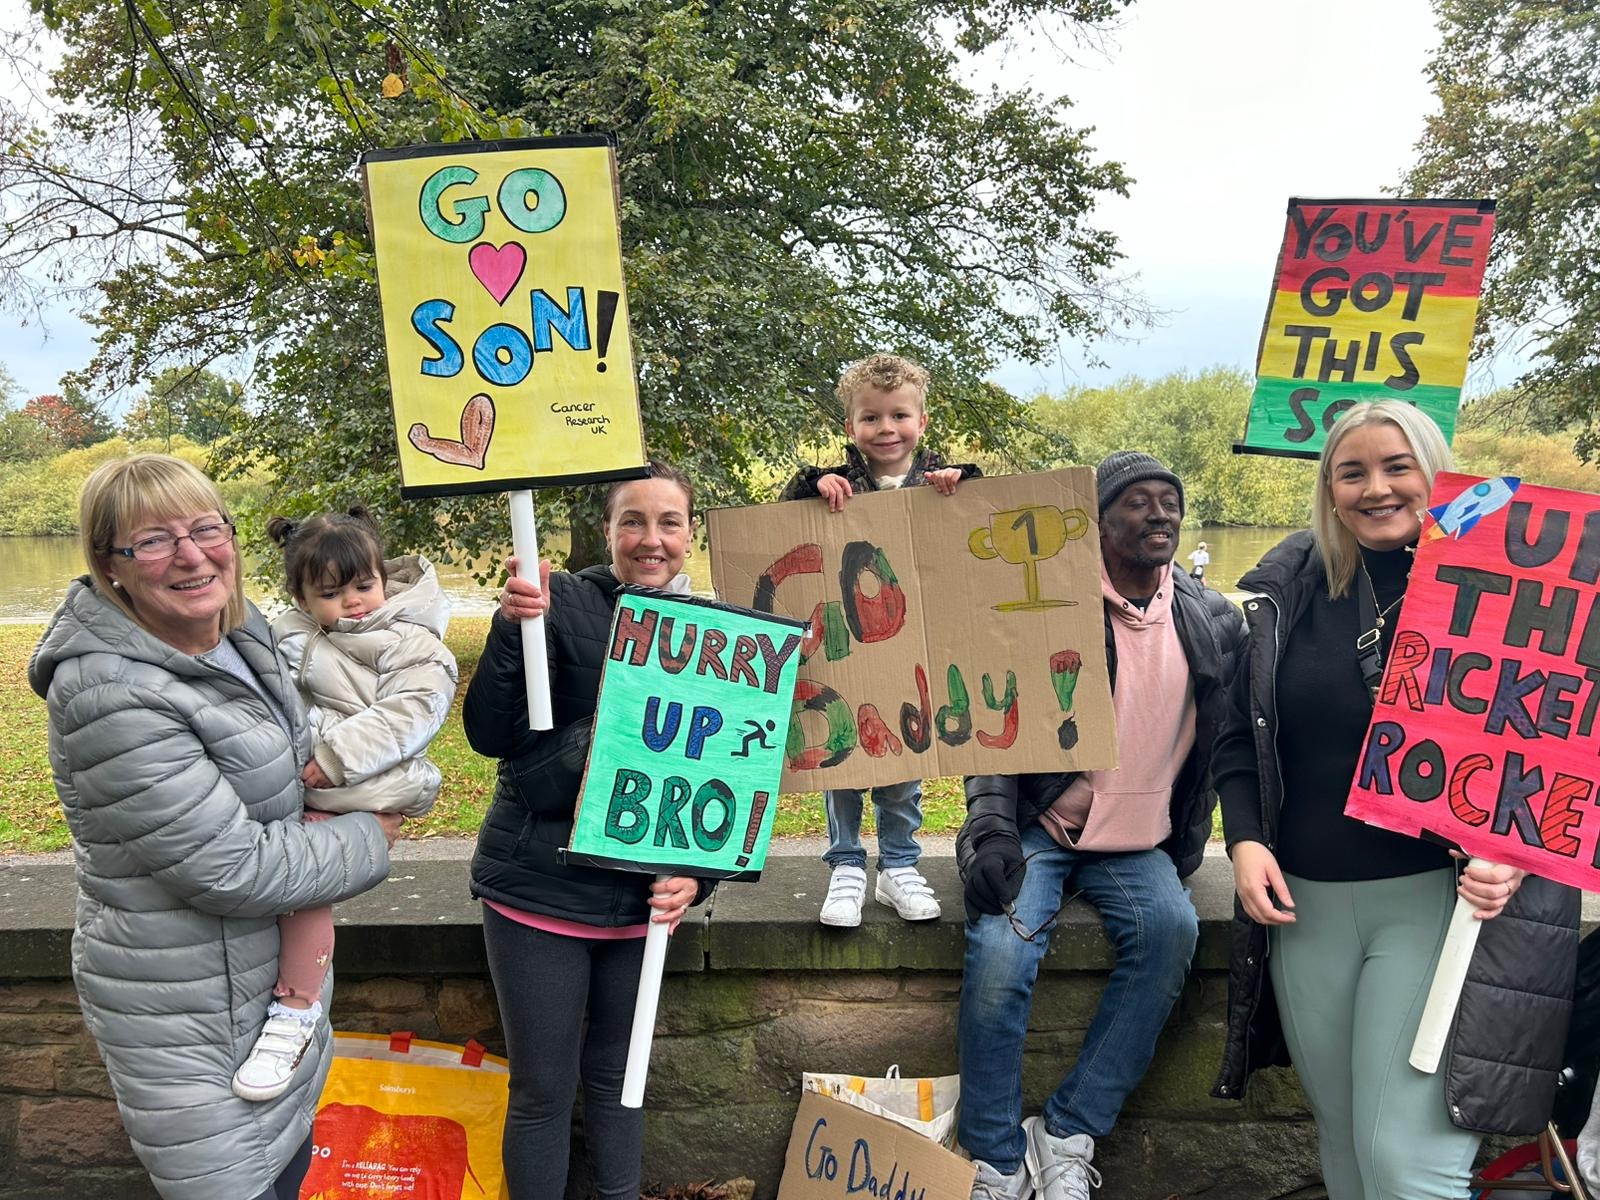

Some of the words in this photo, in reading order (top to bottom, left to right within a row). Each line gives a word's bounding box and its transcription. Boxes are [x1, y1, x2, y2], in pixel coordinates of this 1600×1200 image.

[419, 166, 567, 243] GO
[1290, 208, 1482, 267] YOU'VE
[1300, 267, 1446, 321] GOT
[411, 286, 619, 387] SON!
[1284, 325, 1425, 390] THIS
[550, 402, 596, 413] Cancer
[565, 415, 611, 426] Research
[591, 425, 608, 435] UK
[609, 607, 801, 694] HURRY
[642, 696, 723, 760] UP
[605, 768, 769, 868] BRO!
[1358, 720, 1600, 870] ROCKE
[805, 1118, 838, 1181] Go
